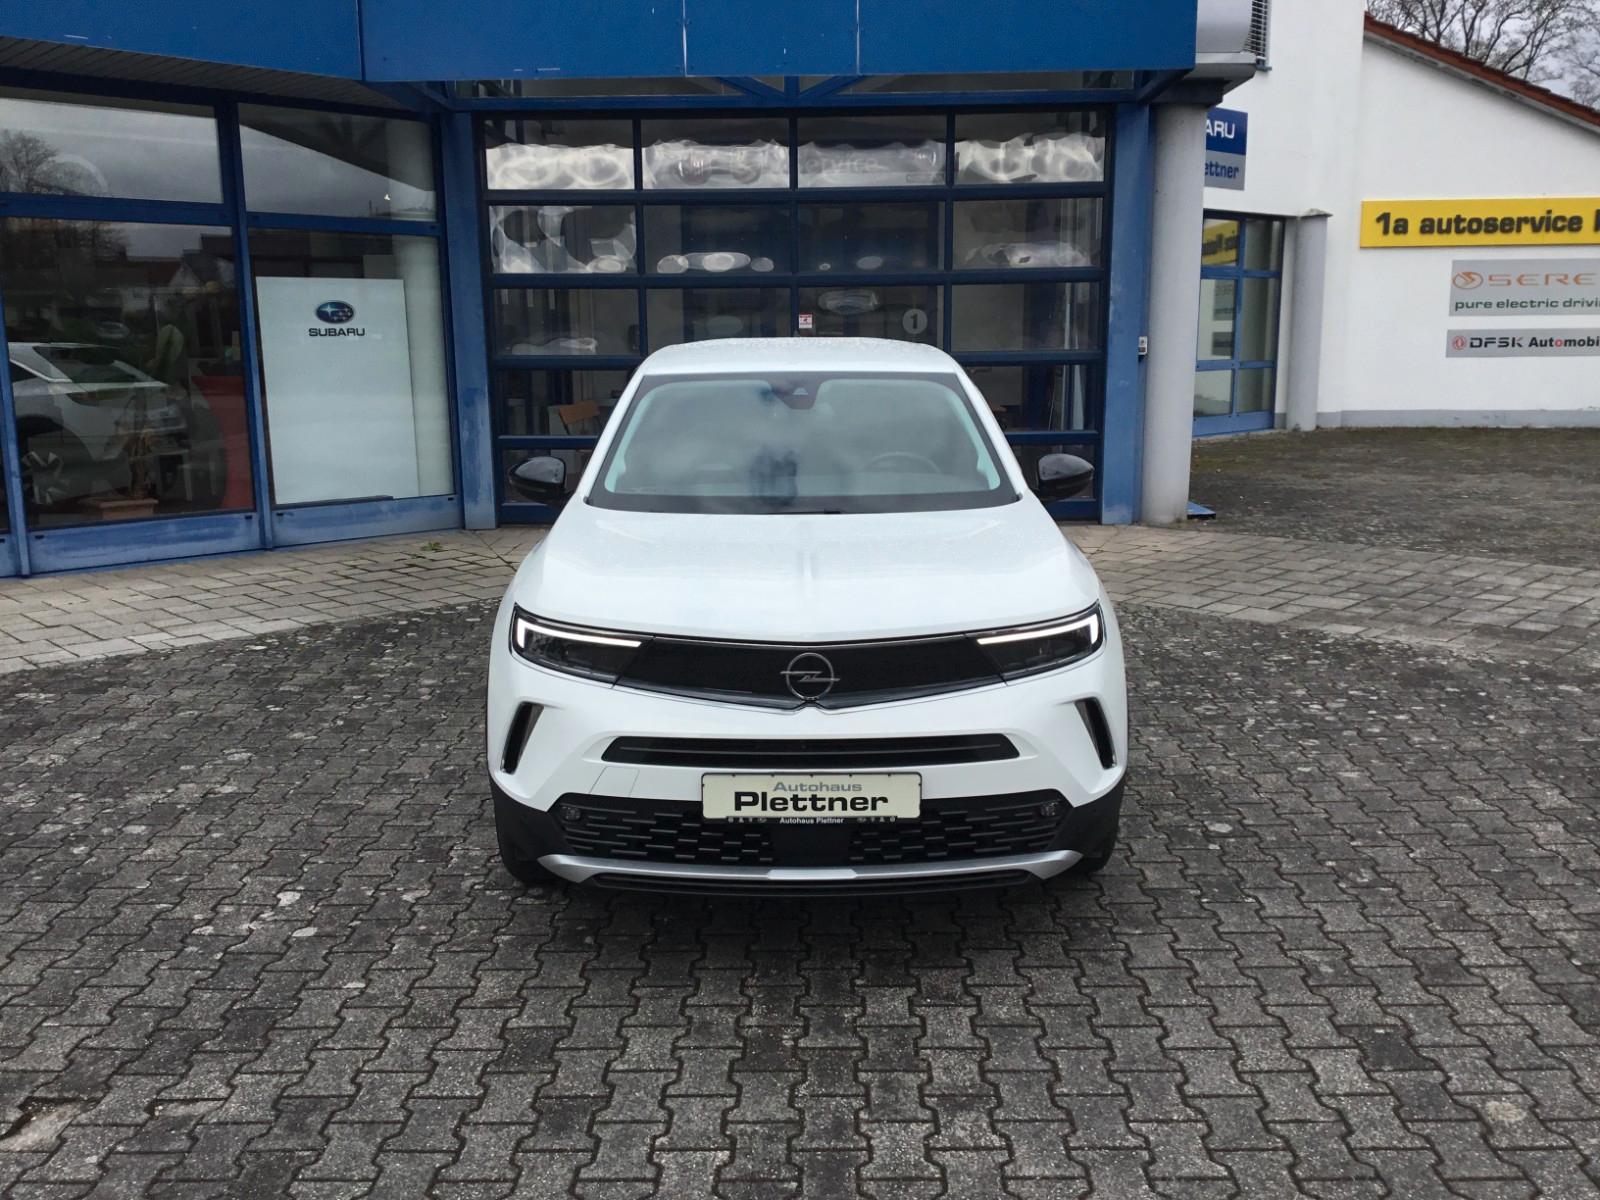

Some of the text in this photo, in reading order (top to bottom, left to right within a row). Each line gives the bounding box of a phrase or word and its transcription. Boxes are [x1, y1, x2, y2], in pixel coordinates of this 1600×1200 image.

[1376, 212, 1408, 235] 1a
[1419, 211, 1583, 235] autoservice
[1455, 297, 1600, 311] pure electric drivi
[910, 313, 918, 329] 1
[308, 328, 365, 337] SUBARU
[1469, 336, 1524, 348] DFSK
[773, 782, 863, 792] Autohaus
[734, 791, 888, 812] Plettner
